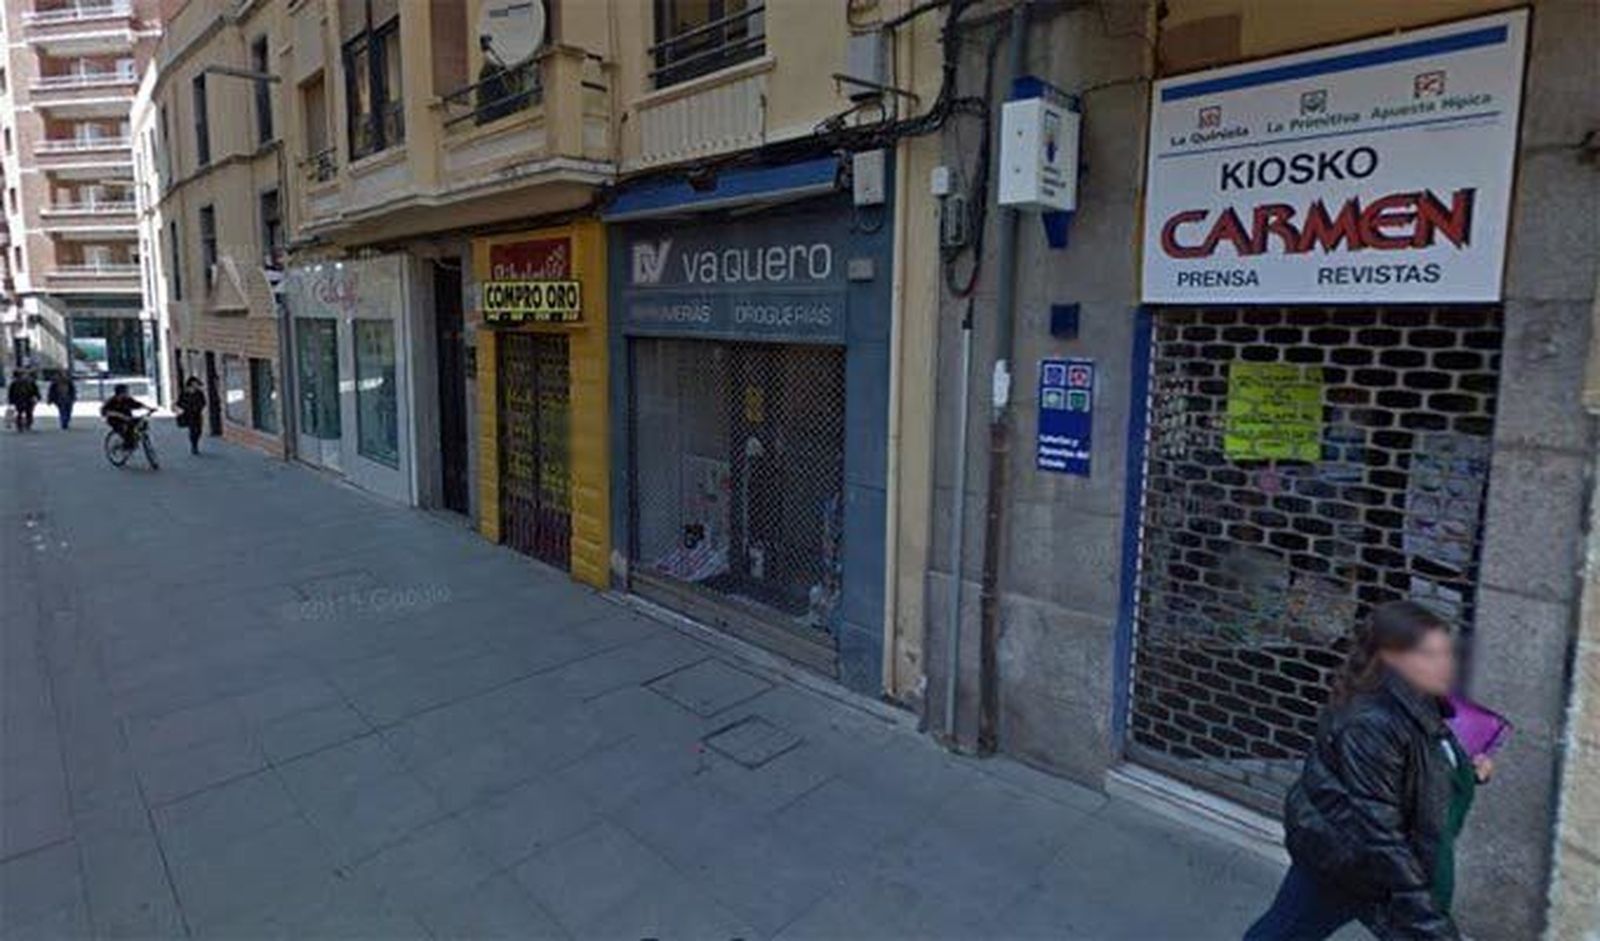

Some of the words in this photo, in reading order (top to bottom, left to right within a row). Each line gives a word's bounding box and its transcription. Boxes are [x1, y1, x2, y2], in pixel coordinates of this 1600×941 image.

[1221, 147, 1379, 191] KIOSKO
[1161, 187, 1478, 259] CARMEN
[1177, 269, 1260, 288] PRENSA
[1318, 263, 1442, 285] REVISTAS
[486, 284, 542, 309] COMPRO
[546, 284, 578, 309] ORO
